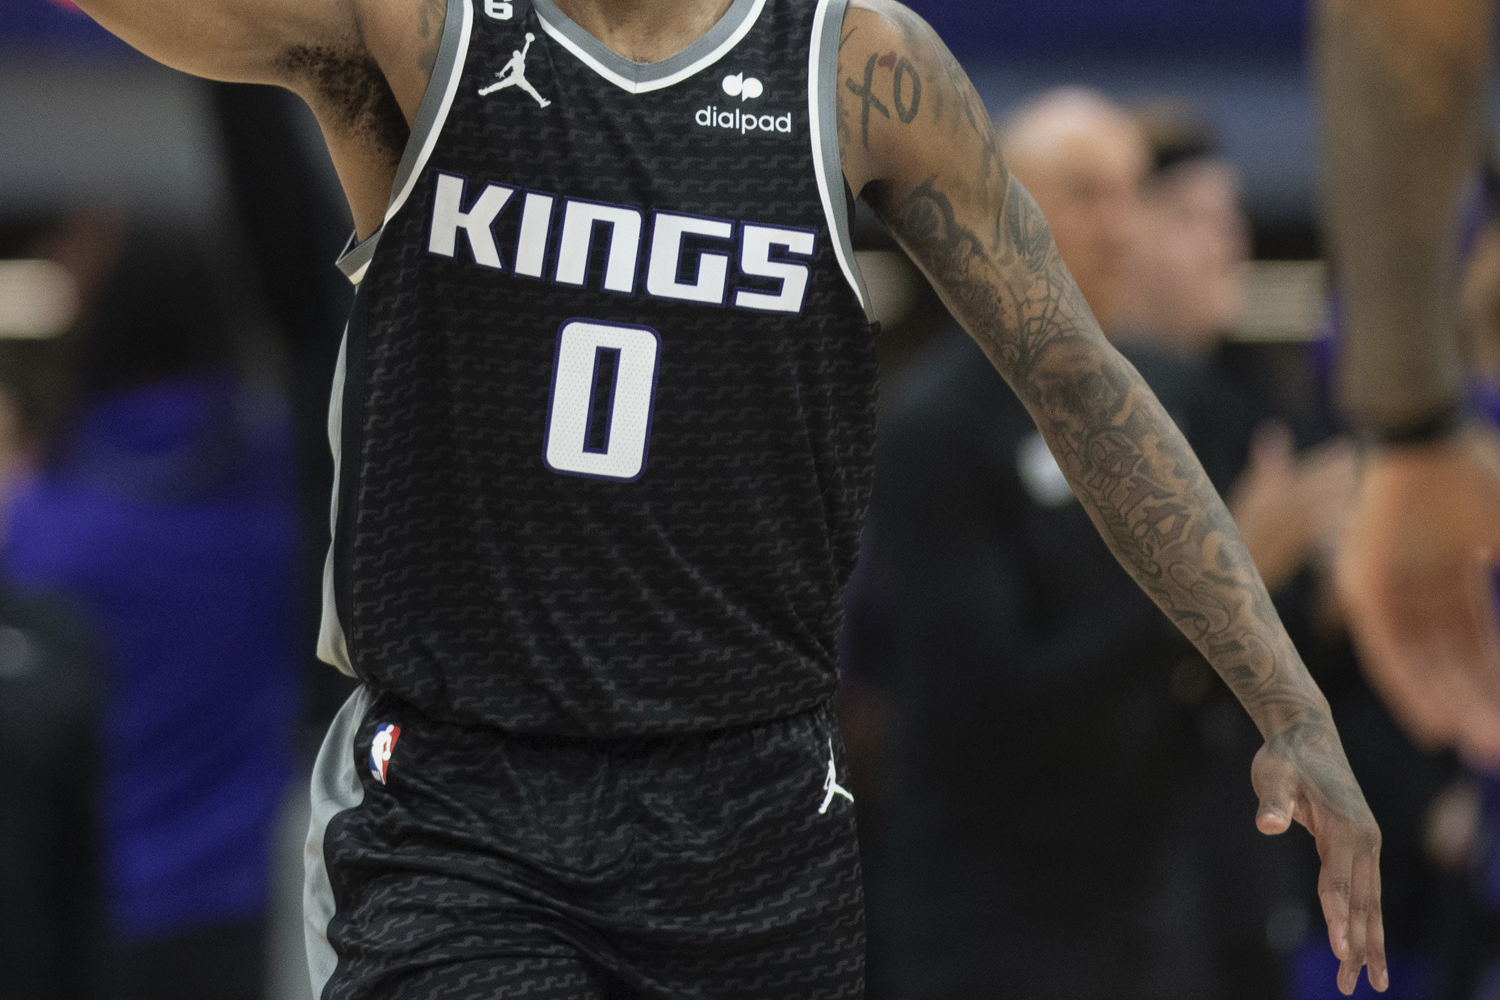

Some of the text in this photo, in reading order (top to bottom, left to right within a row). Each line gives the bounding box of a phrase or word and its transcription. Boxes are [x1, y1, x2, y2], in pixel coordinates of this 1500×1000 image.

[694, 105, 792, 135] dialpad
[427, 172, 816, 314] KINGS
[543, 319, 661, 482] 0
